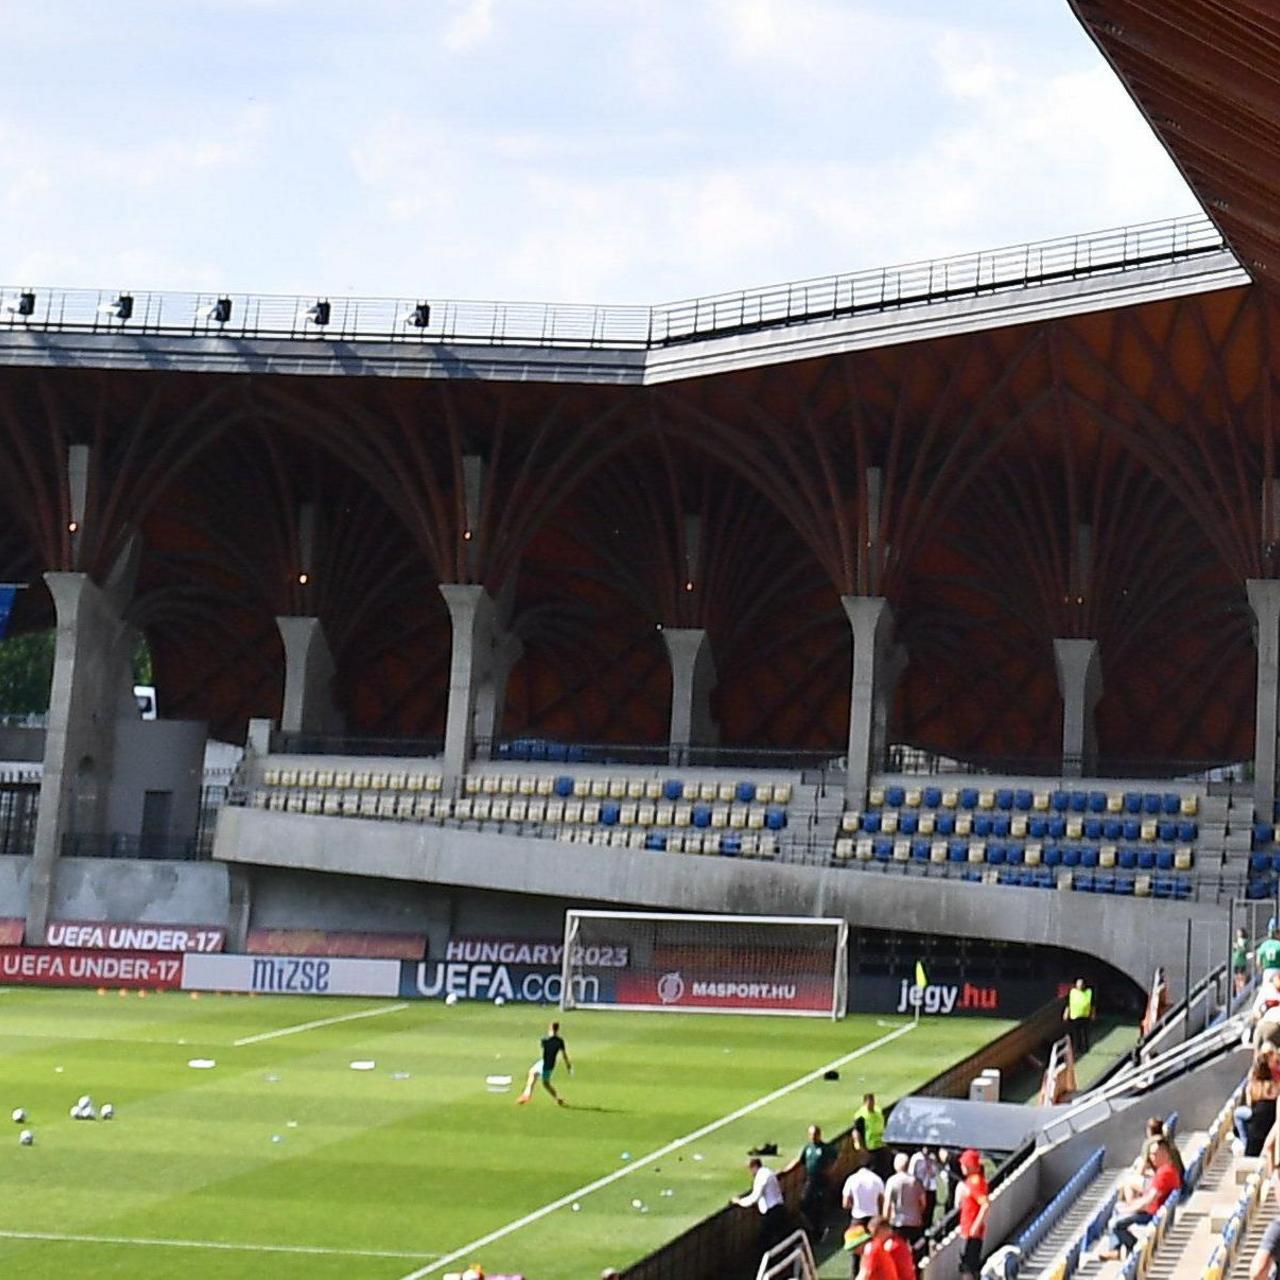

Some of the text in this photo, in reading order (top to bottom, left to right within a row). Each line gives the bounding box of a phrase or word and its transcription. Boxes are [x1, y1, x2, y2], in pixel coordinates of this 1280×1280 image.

[47, 926, 220, 952] UEFA UNDER-17
[446, 941, 565, 964] HUNGARY
[3, 954, 180, 981] UEFA UNDER-17
[692, 982, 796, 999] M4SPORT.HU
[897, 978, 998, 1013] jegy.hu
